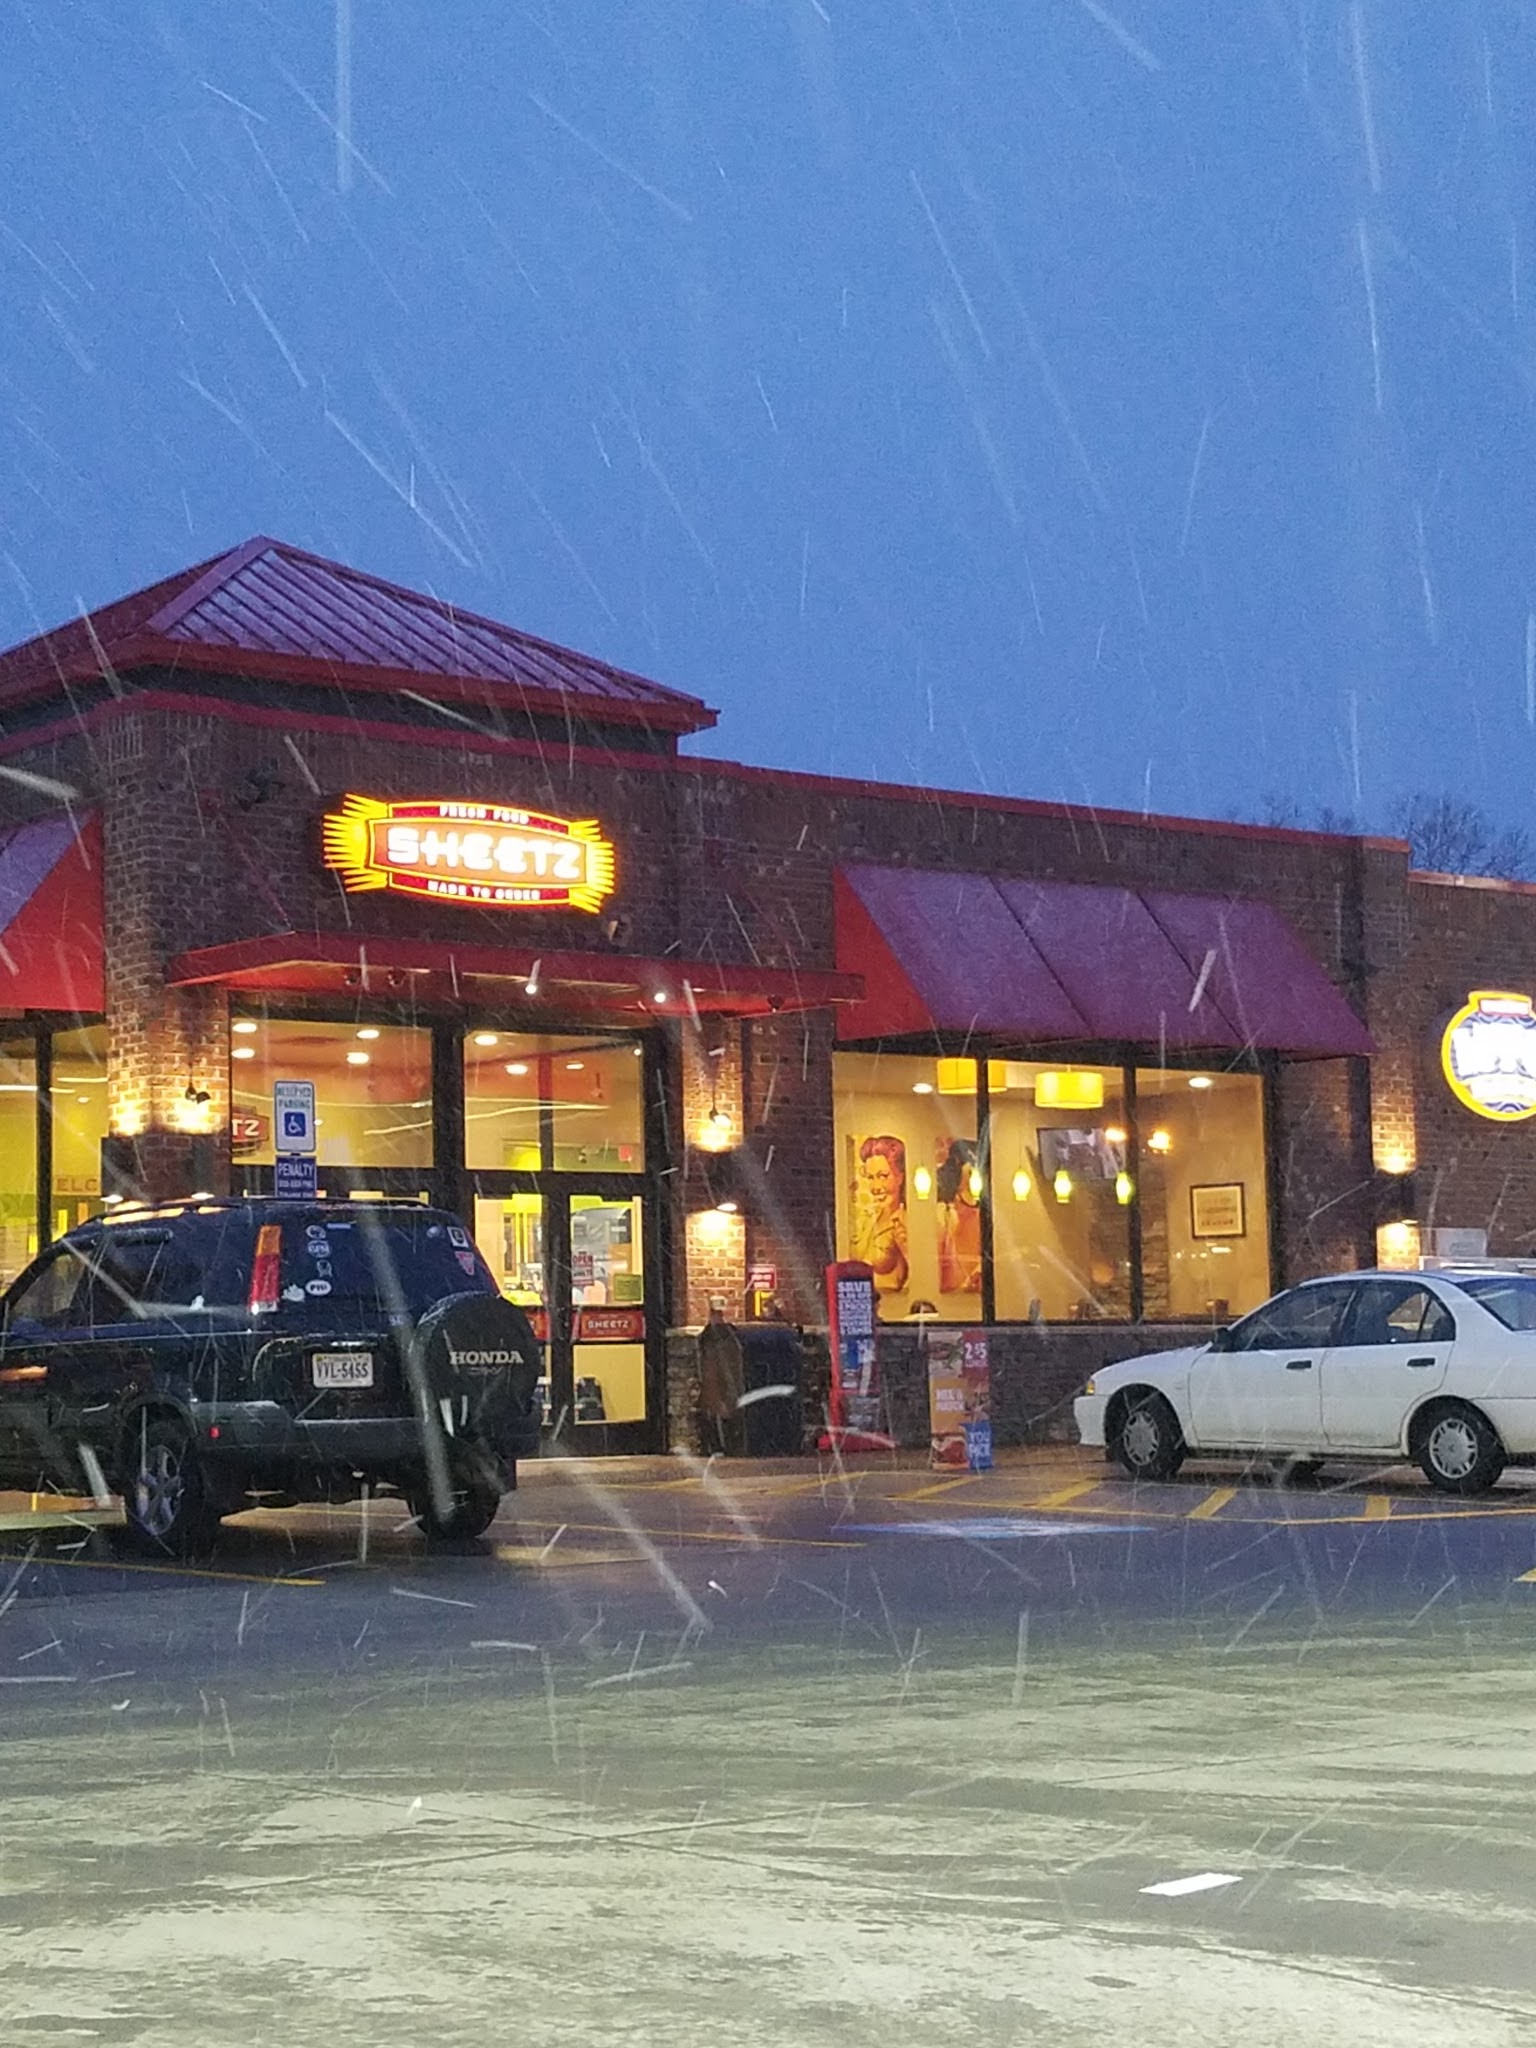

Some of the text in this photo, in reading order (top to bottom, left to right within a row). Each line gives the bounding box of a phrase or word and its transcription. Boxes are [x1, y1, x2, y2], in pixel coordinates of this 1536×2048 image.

[493, 809, 529, 825] FOOD
[387, 826, 581, 879] SHEETZ
[427, 880, 467, 896] MADE
[472, 886, 491, 898] TO
[278, 1163, 313, 1177] PENALTY
[837, 1281, 871, 1292] SAVE
[449, 1351, 524, 1365] HONDA
[969, 1431, 991, 1443] YOU
